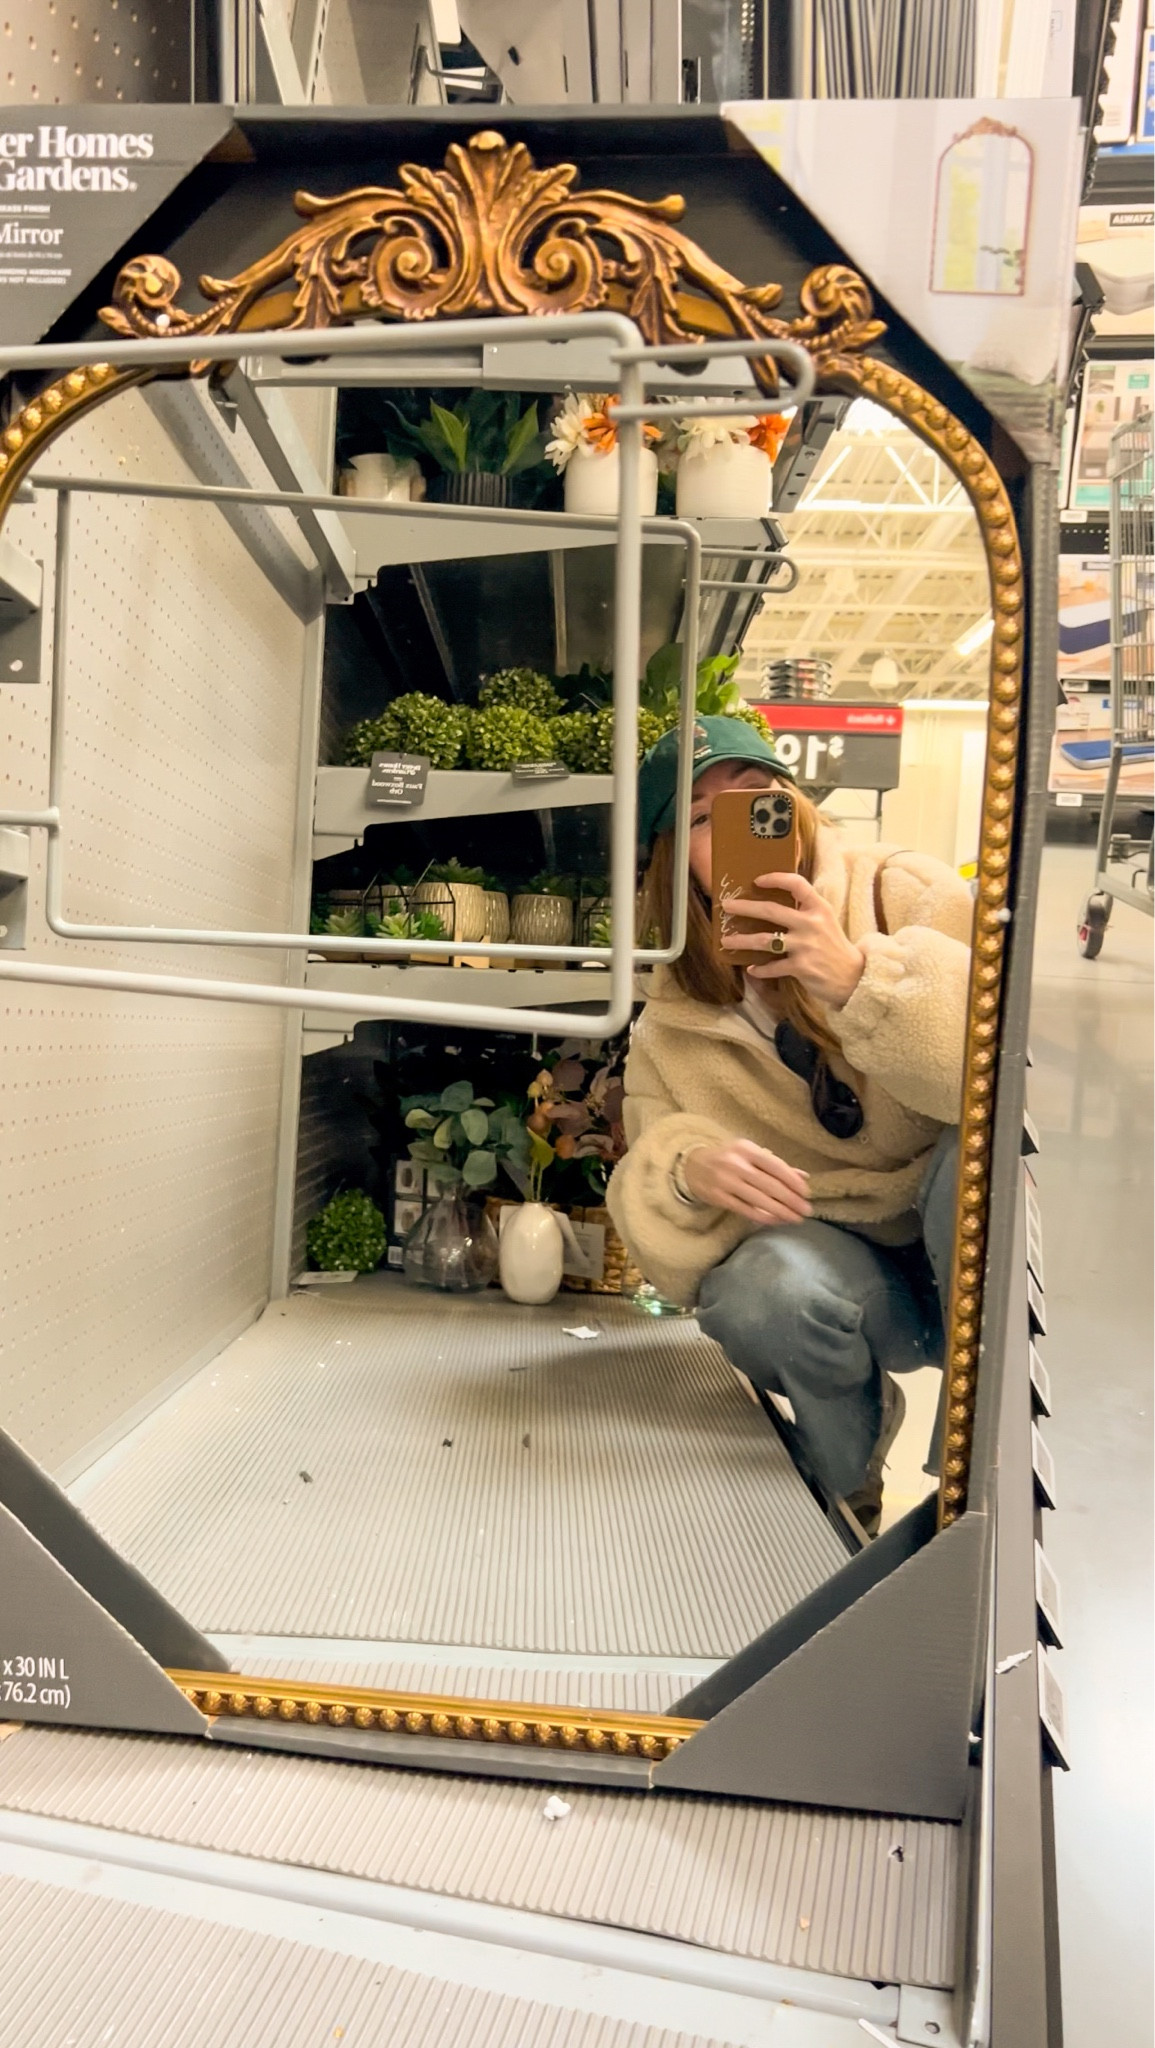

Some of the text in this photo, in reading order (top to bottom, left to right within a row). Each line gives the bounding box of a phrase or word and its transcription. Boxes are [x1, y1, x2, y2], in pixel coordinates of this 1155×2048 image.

[38, 125, 154, 158] Homes
[0, 221, 64, 245] Mirror
[15, 1655, 36, 1678] 30
[39, 1656, 56, 1679] IN
[60, 1658, 70, 1680] L
[40, 1684, 71, 1710] cm)
